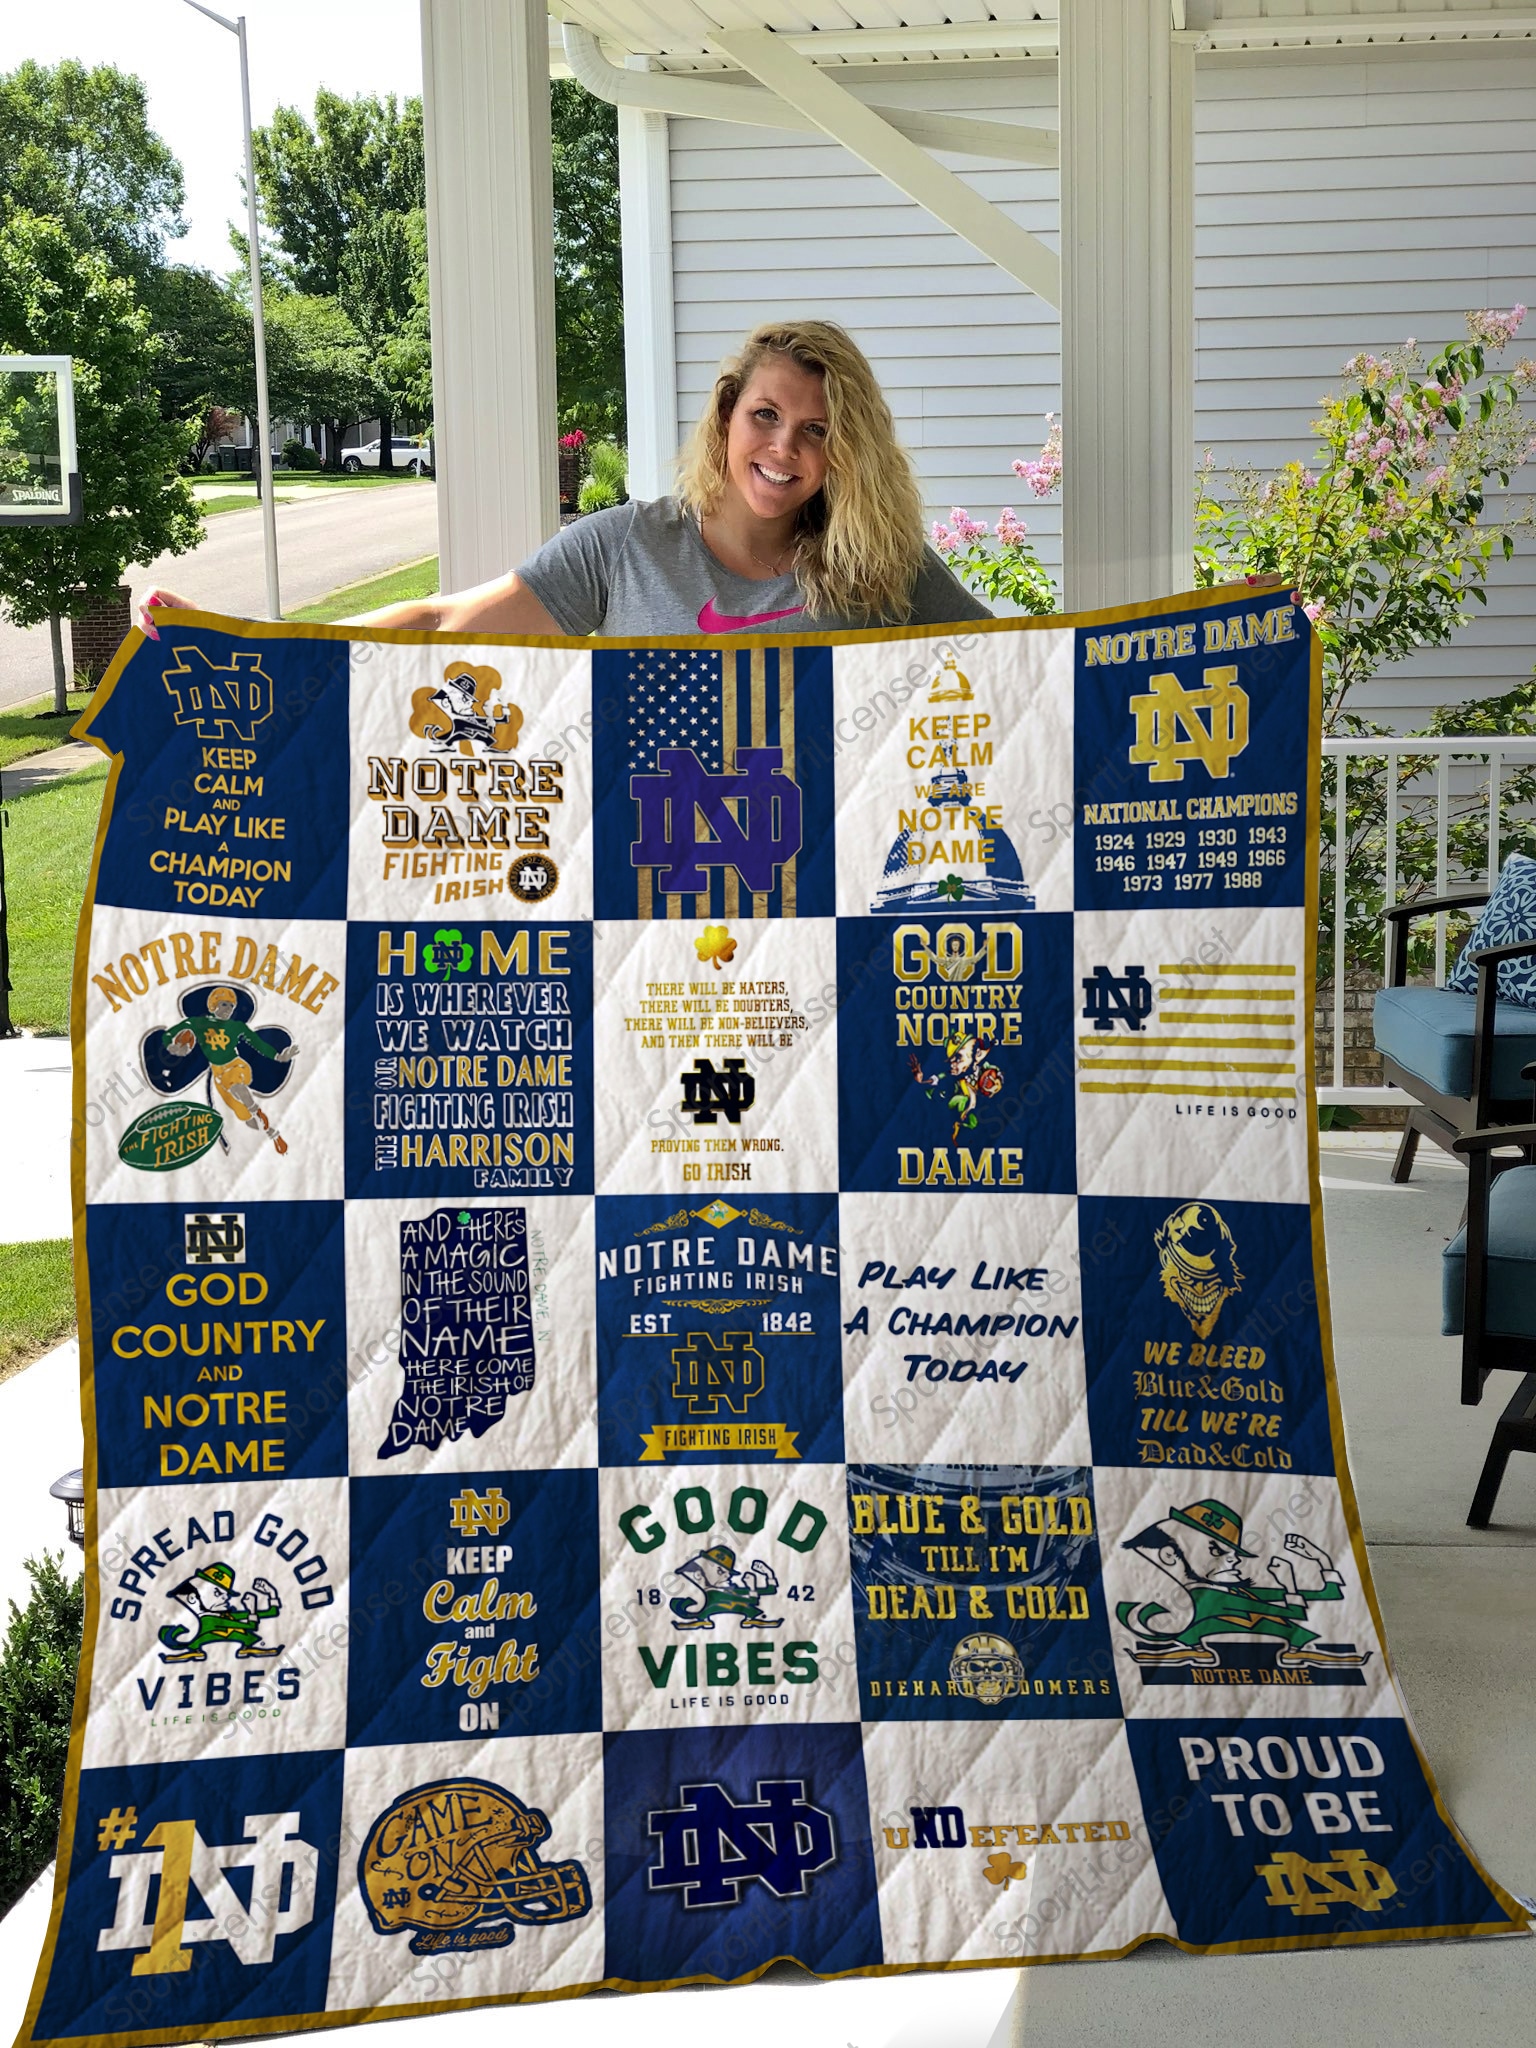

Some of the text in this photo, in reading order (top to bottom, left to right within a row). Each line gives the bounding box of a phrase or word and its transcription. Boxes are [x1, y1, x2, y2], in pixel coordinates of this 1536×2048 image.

[12, 489, 61, 502] SPALDING
[1084, 605, 1296, 666] NOTRE DAME
[908, 713, 991, 741] KEEP
[202, 747, 257, 770] KEEP
[906, 742, 994, 769] CALM
[194, 773, 264, 797] CALM
[368, 756, 563, 803] NOTRE
[915, 783, 986, 799] WE ARE
[212, 799, 241, 811] AND
[898, 806, 1004, 833] NOTRE
[1083, 792, 1298, 825] NATIONAL CHAMPIONS
[164, 807, 286, 839] PLAY LIKE
[382, 805, 550, 849] DAME
[217, 841, 230, 852] A
[906, 838, 996, 866] DAME
[1094, 826, 1286, 850] 1924 1929 1930 1943
[150, 850, 292, 882] CHAMPION
[383, 853, 503, 881] FIGHTING
[1095, 849, 1286, 872] 1946 1947 1949 1966
[173, 880, 264, 908] TODAY
[434, 878, 504, 905] IRISH
[1123, 872, 1262, 892] 1973 1977 1988
[892, 922, 1023, 982] GOD
[92, 931, 340, 1015] NOTRE DAME
[376, 982, 571, 1016] IS WHEREVER
[646, 981, 789, 996] THERE WILL BE HATERS,
[895, 984, 1023, 1010] COUNTRY
[639, 999, 794, 1013] THERE WILL BE DOUBTERS,
[375, 1019, 572, 1051] WE WATCH
[624, 1018, 662, 1031] THERE
[667, 1018, 696, 1031] WILL
[700, 1017, 714, 1030] BE
[896, 1012, 1023, 1046] NOTRE
[641, 1035, 792, 1048] AND THEN THERE WILL BE
[399, 1055, 572, 1088] NOTRE DAME
[374, 1093, 573, 1130] FIGHTING IRISH
[1176, 1104, 1297, 1119] LIFE IS GOOD
[153, 1128, 209, 1168] IRISH
[401, 1132, 574, 1168] HARRISON
[651, 1139, 784, 1152] PROVING THEM WRONG.
[474, 1168, 574, 1188] FAMILY
[683, 1163, 752, 1181] GO IRISH
[898, 1147, 1023, 1185] DAME
[403, 1209, 526, 1243] AND THERE'S
[402, 1243, 526, 1269] A MAGIC
[599, 1237, 837, 1280] NOTRE DAME
[166, 1272, 269, 1307] GOD
[402, 1270, 528, 1296] IN THE SOUND
[633, 1272, 803, 1296] FIGHTING IRISH
[403, 1295, 531, 1324] OF THEIR
[630, 1312, 812, 1334] EST 1842
[844, 1306, 869, 1335] A
[111, 1319, 326, 1359] COUNTRY
[402, 1324, 533, 1358] NAME
[406, 1357, 533, 1377] HERE COME
[1144, 1340, 1266, 1370] WE BLEED
[196, 1365, 243, 1383] AND
[407, 1375, 534, 1395] THE IRISH OF
[143, 1390, 287, 1429] NOTRE
[398, 1395, 503, 1418] NOTRE
[392, 1417, 467, 1447] DAME
[665, 1429, 776, 1446] FIGHTING IRISH
[1141, 1408, 1282, 1438] TILL WE'RE
[160, 1439, 285, 1477] DAME
[618, 1486, 828, 1554] GOOD
[852, 1495, 1093, 1535] BLUE & GOLD
[110, 1510, 334, 1622] SPREAD GOOD
[446, 1545, 513, 1575] KEEP
[921, 1545, 1029, 1573] TILL I'M
[423, 1577, 538, 1624] Calm
[637, 1586, 815, 1606] 18 42
[866, 1585, 1090, 1620] DEAD & COLD
[465, 1623, 495, 1640] and
[421, 1639, 540, 1698] Fight
[637, 1641, 819, 1688] VIBES
[1192, 1668, 1313, 1684] NOTRE DAME
[137, 1668, 300, 1711] VIBES
[671, 1695, 789, 1709] LIFE IS GOOD
[459, 1702, 500, 1731] ON
[1178, 1735, 1386, 1781] PROUD
[376, 1793, 493, 1858] GAME
[1210, 1790, 1394, 1837] TO BE
